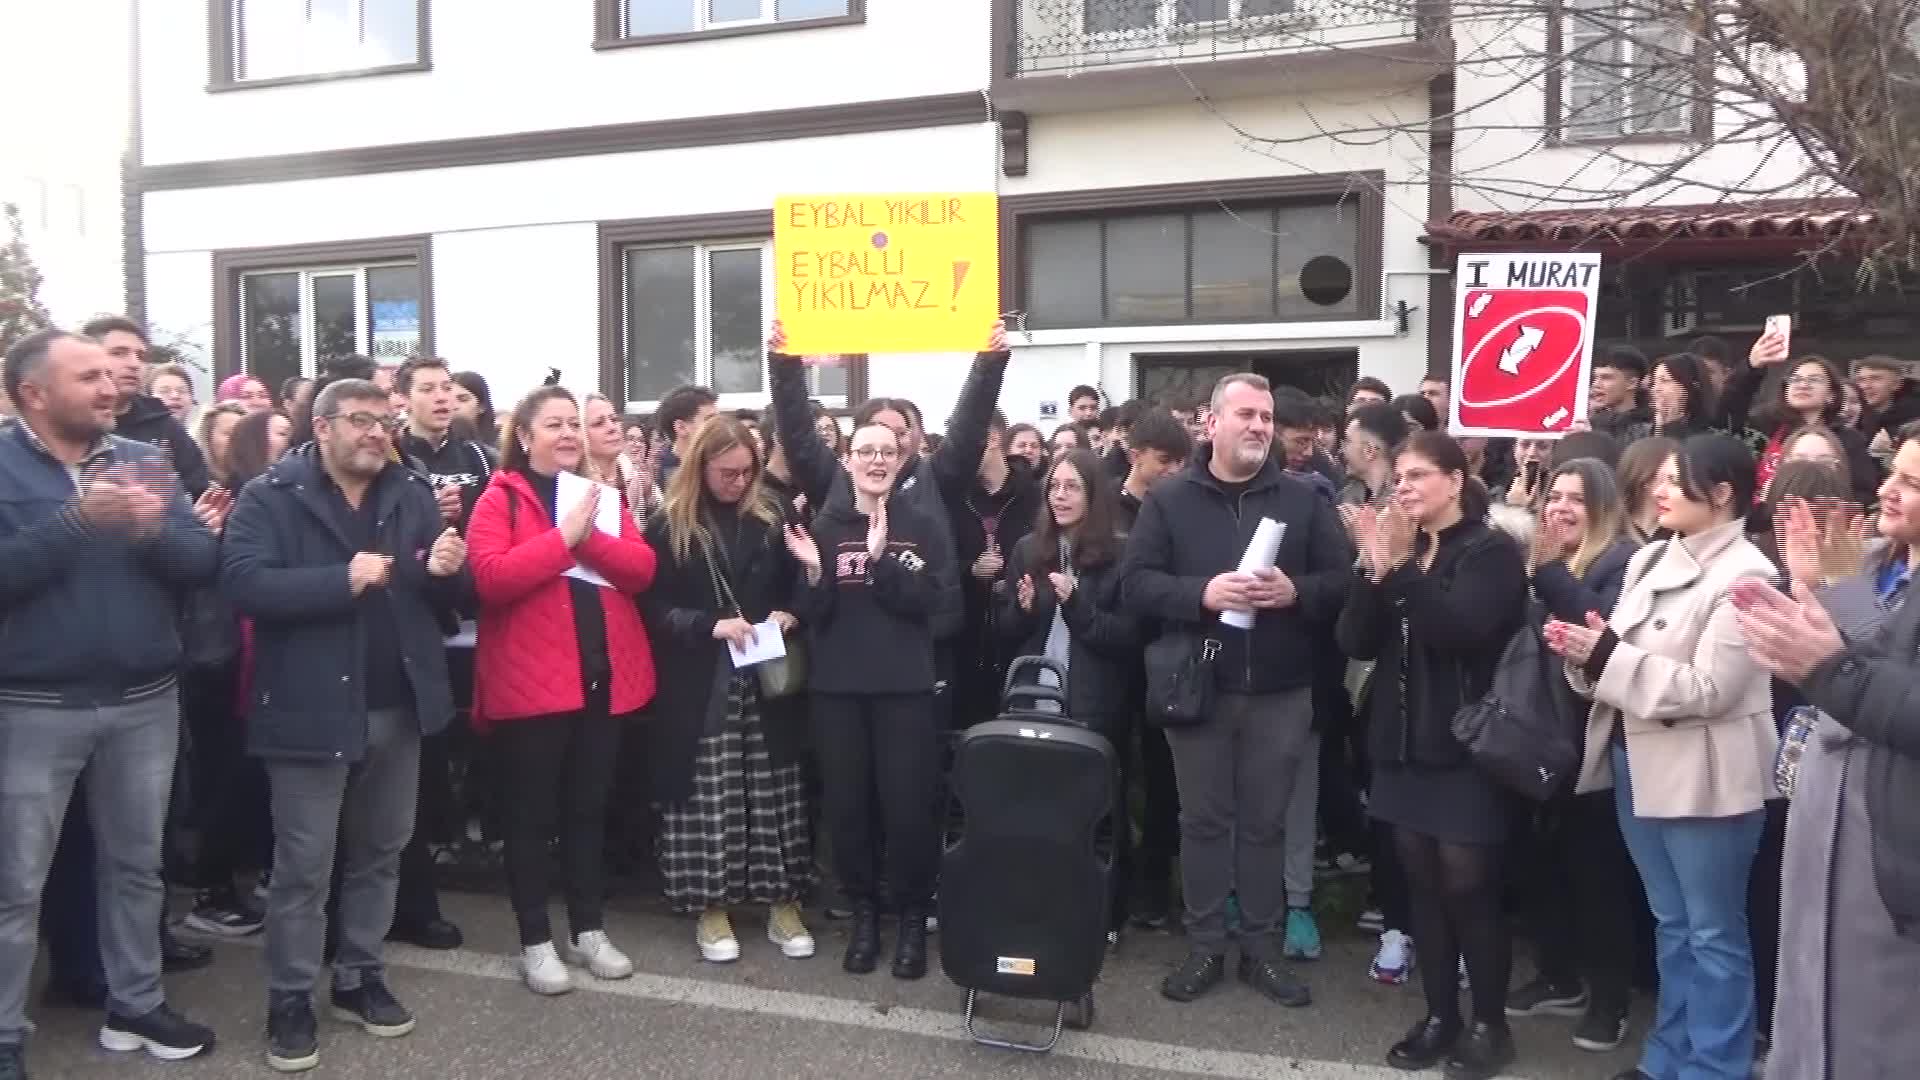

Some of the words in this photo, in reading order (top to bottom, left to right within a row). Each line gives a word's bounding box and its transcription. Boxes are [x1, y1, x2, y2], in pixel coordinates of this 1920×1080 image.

[791, 202, 877, 228] EYBAL
[885, 198, 966, 226] YIKILIR
[1465, 261, 1490, 288] I
[1507, 261, 1598, 288] MURAT
[792, 281, 939, 312] YIKILMAZ
